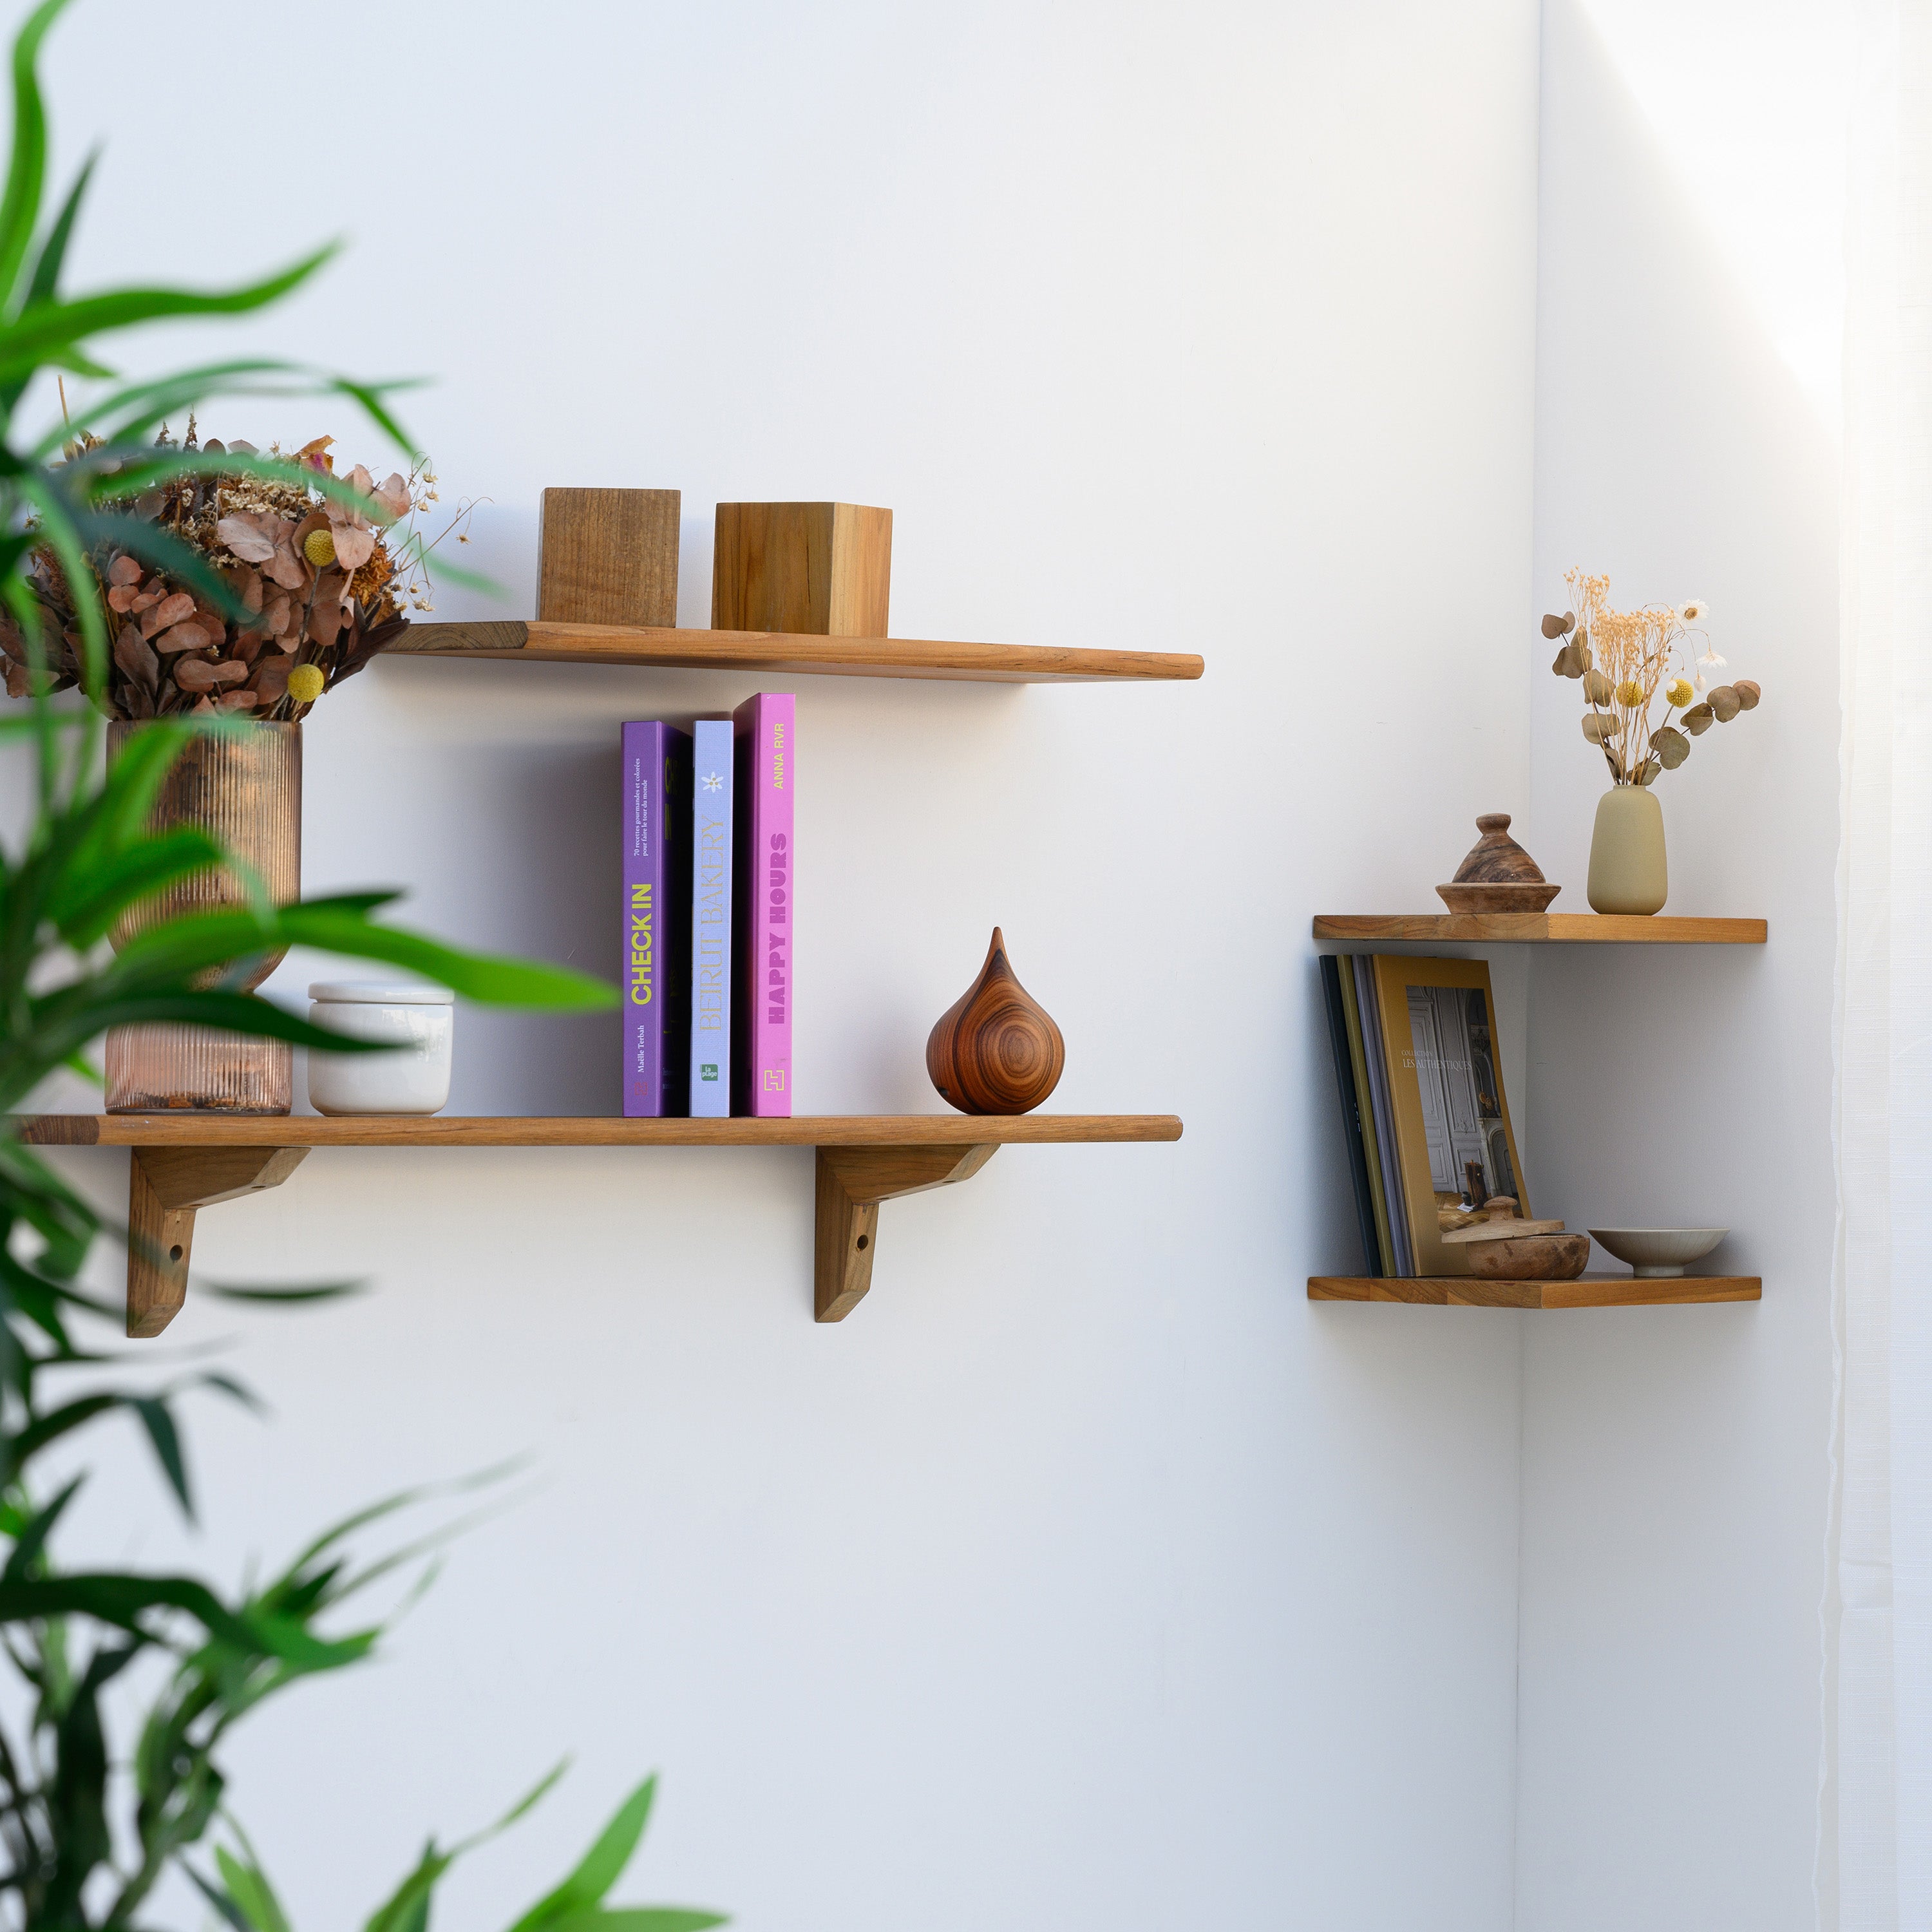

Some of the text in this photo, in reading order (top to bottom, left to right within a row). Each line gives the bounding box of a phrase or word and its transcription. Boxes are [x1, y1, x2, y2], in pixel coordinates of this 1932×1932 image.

[773, 723, 784, 790] ANNA RVR
[631, 884, 652, 1005] CHECK IN
[700, 815, 724, 1031] BEIRUT BAKERY
[768, 833, 787, 1024] HAPPY HOURS
[1403, 1059, 1472, 1072] LES AUTHENTIQUES
